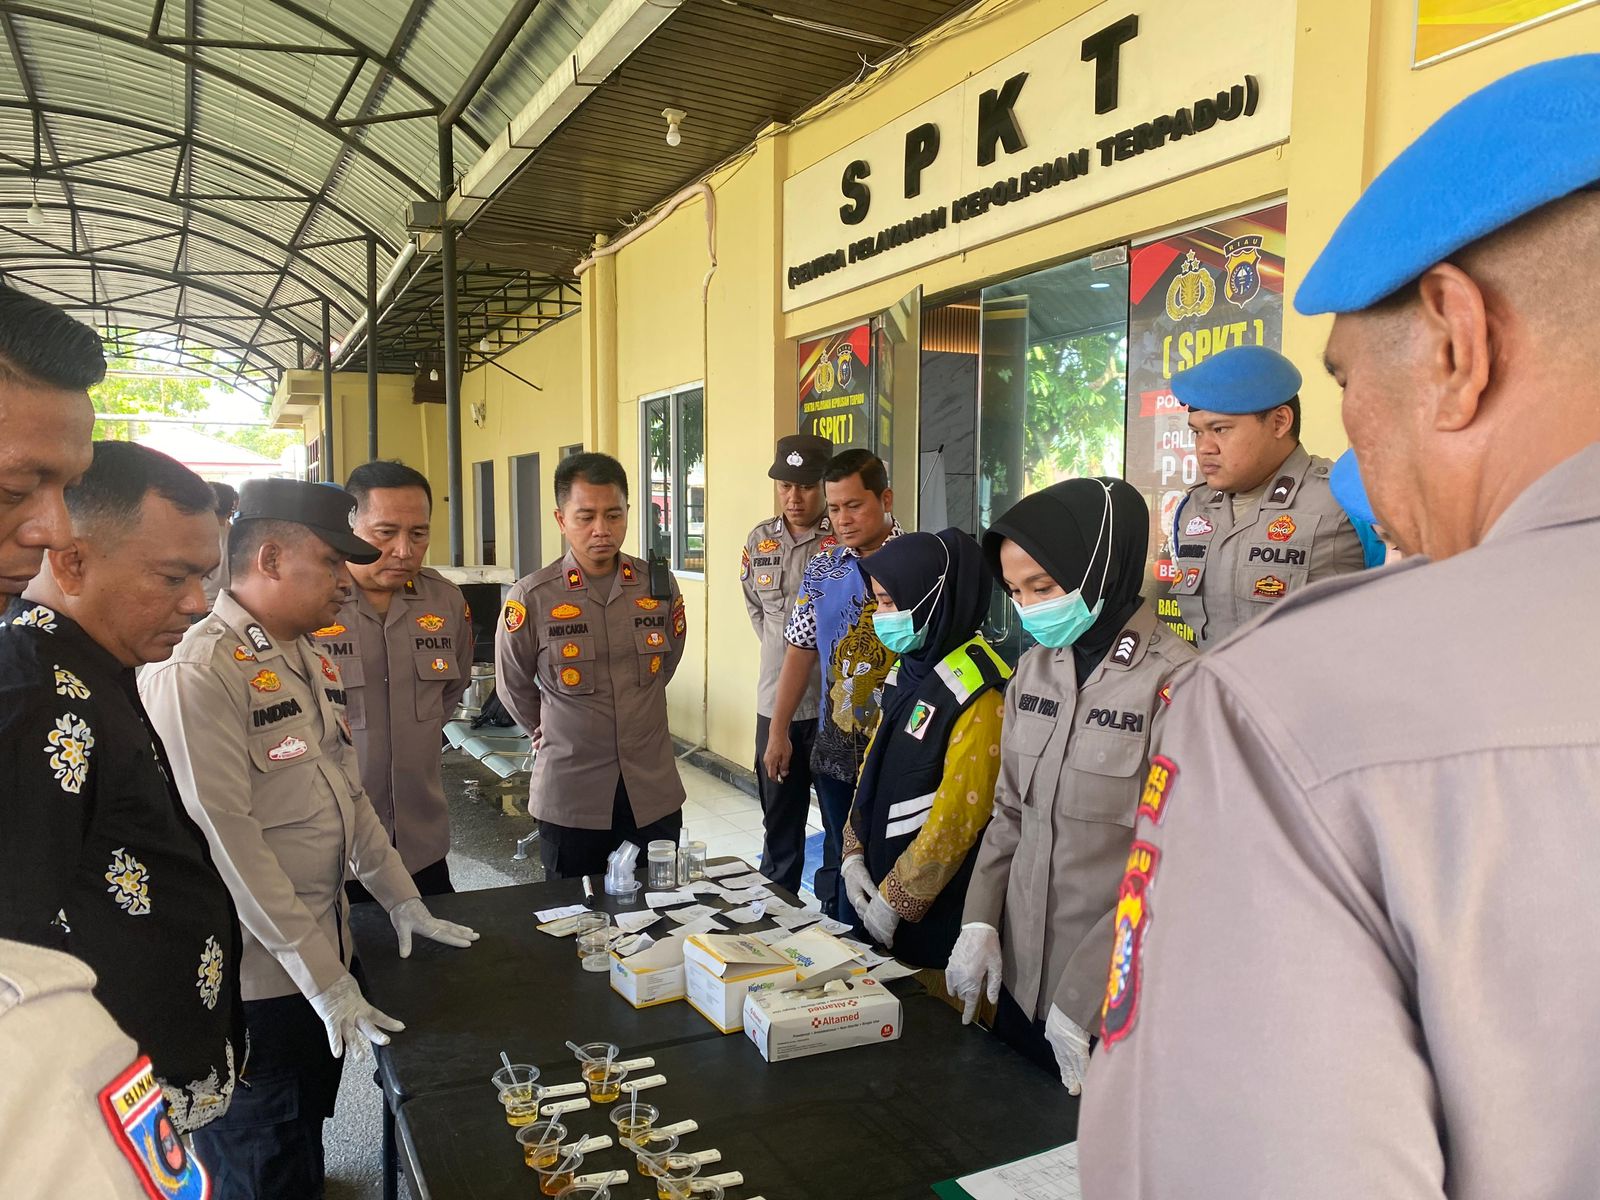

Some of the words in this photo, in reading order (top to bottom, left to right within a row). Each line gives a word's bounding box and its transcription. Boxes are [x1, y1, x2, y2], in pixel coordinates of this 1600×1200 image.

[952, 148, 1089, 223] KEPOLISIAN
[1096, 74, 1259, 167] TERPADU)
[1229, 238, 1258, 251] RIAU
[1248, 547, 1306, 565] POLRI
[415, 637, 452, 650] POLRI
[252, 698, 302, 728] INDRA
[1085, 708, 1144, 733] POLRI
[822, 1012, 860, 1026] Altamed
